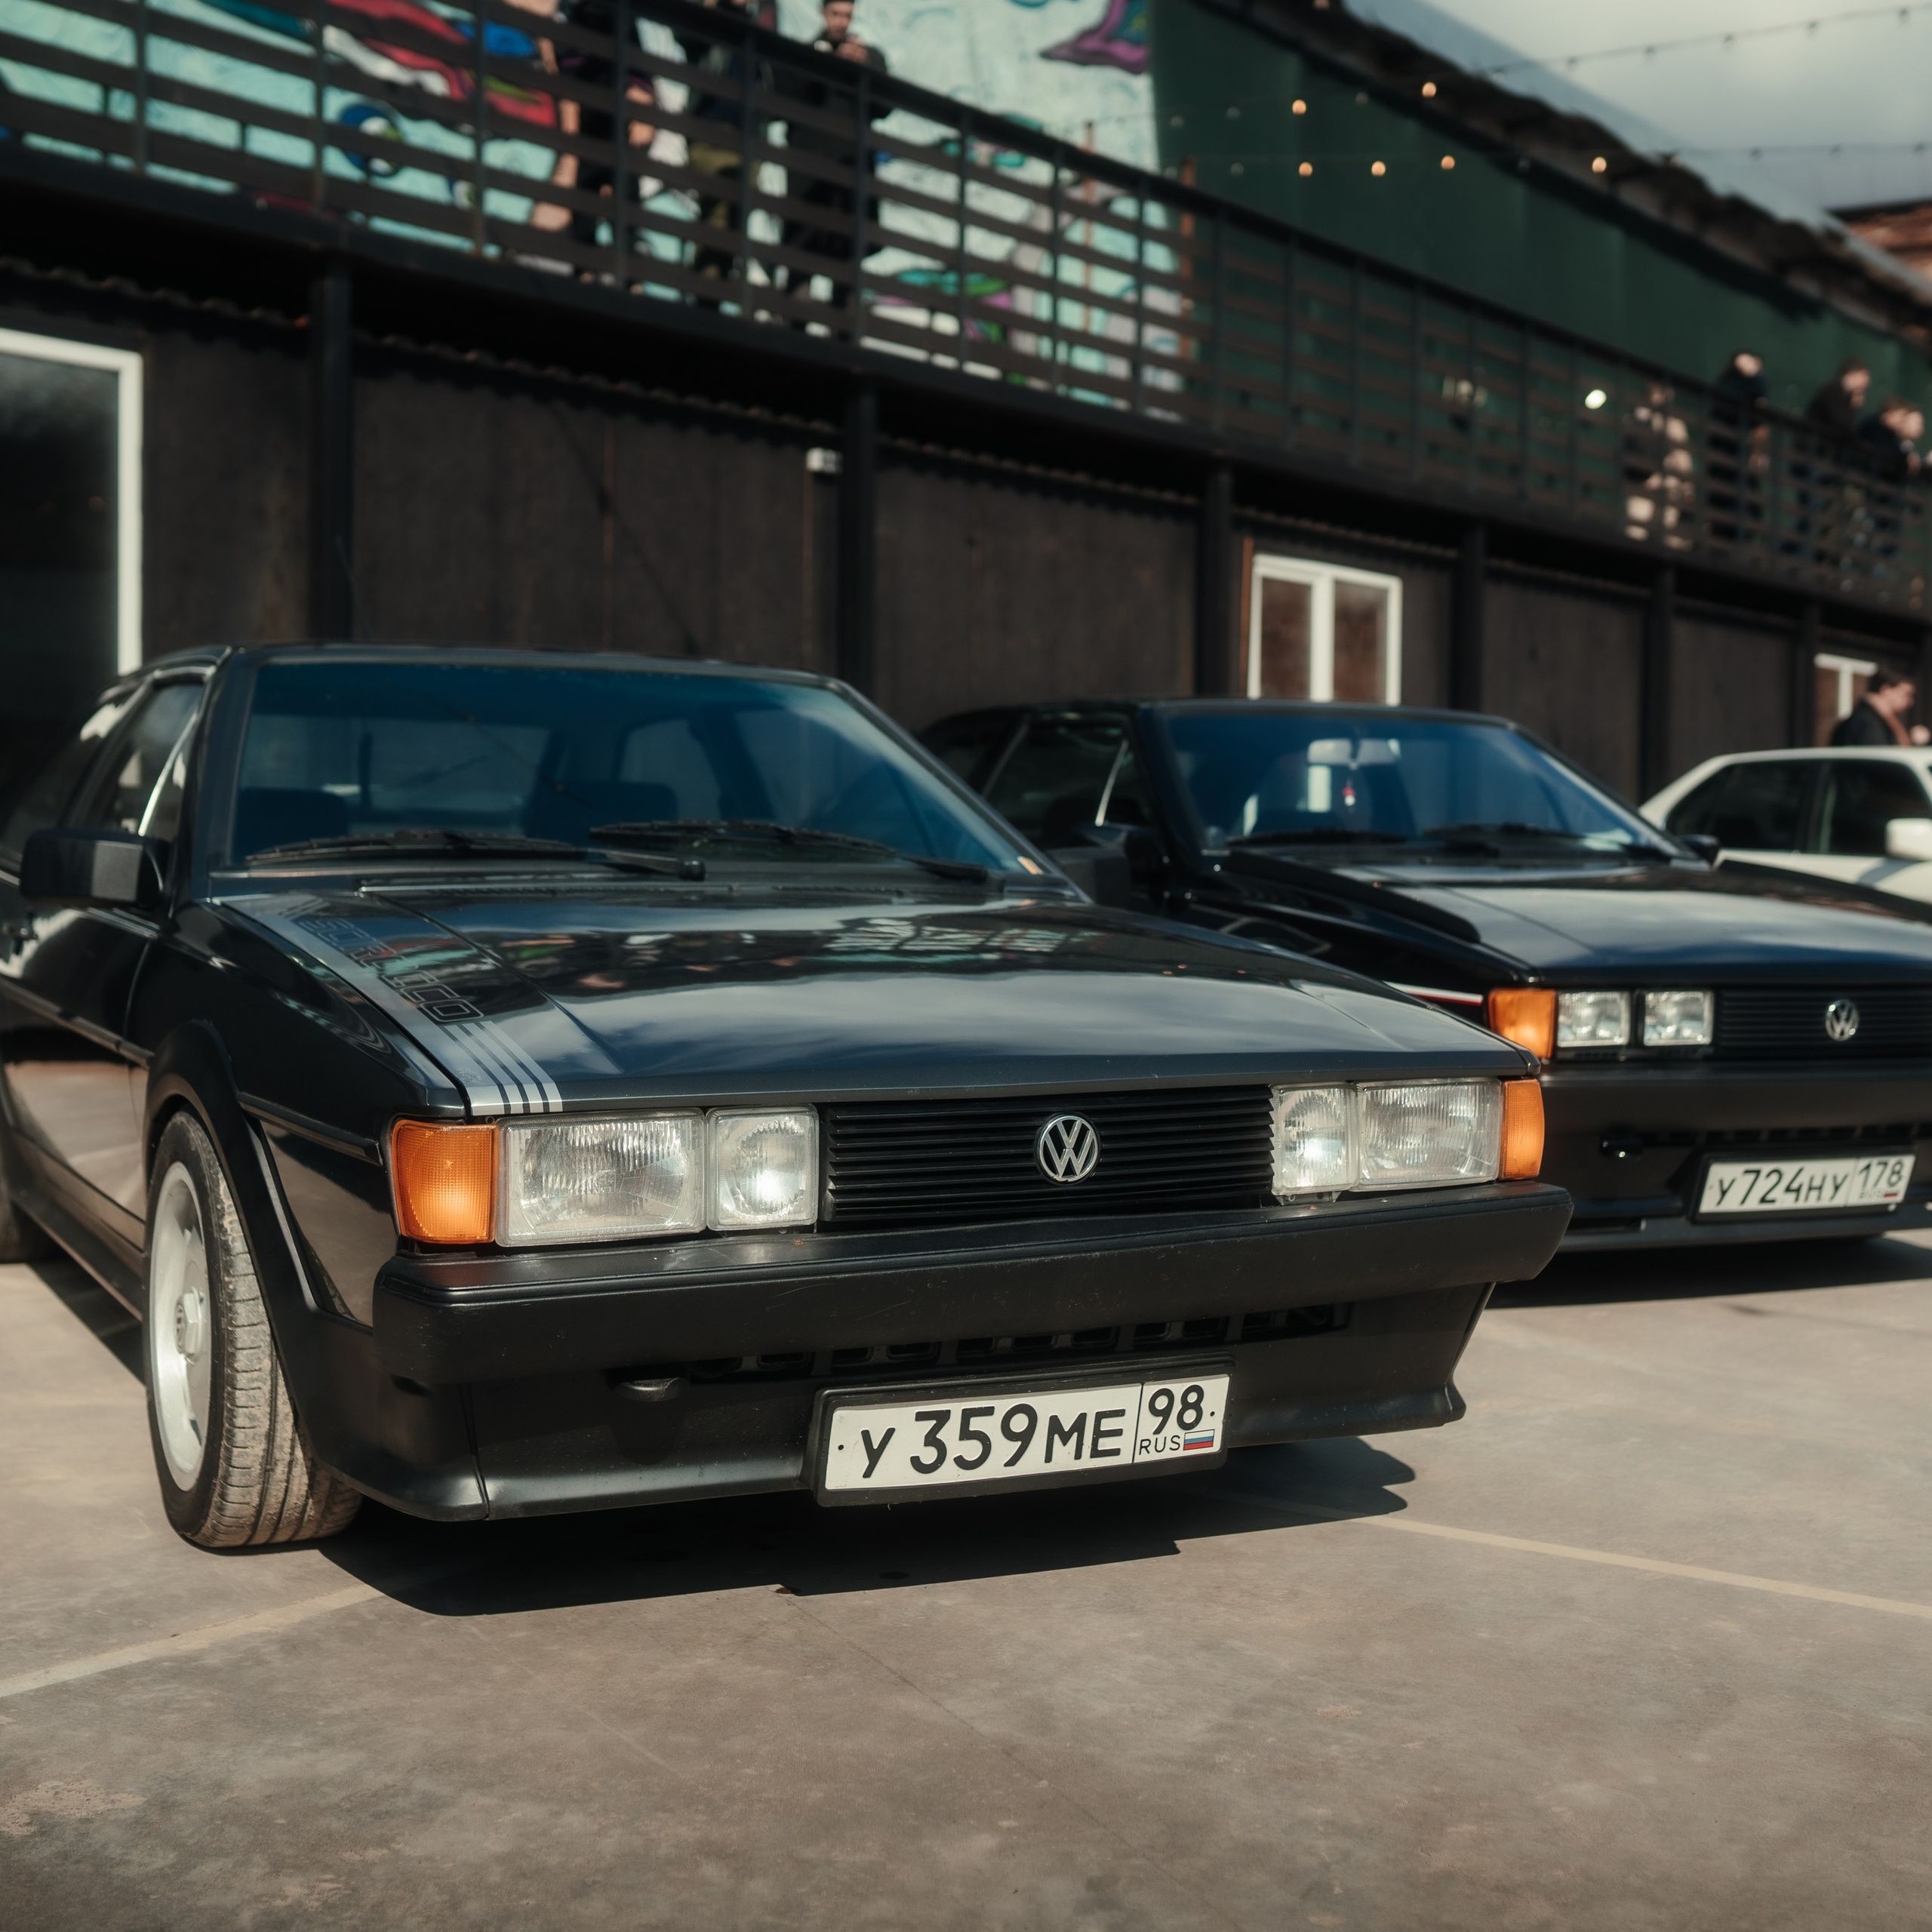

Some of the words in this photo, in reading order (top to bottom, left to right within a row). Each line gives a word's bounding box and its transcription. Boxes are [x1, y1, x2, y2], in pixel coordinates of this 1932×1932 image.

[1859, 1160, 1904, 1189] 178
[1148, 1384, 1204, 1435] 98
[1139, 1435, 1180, 1455] RUS
